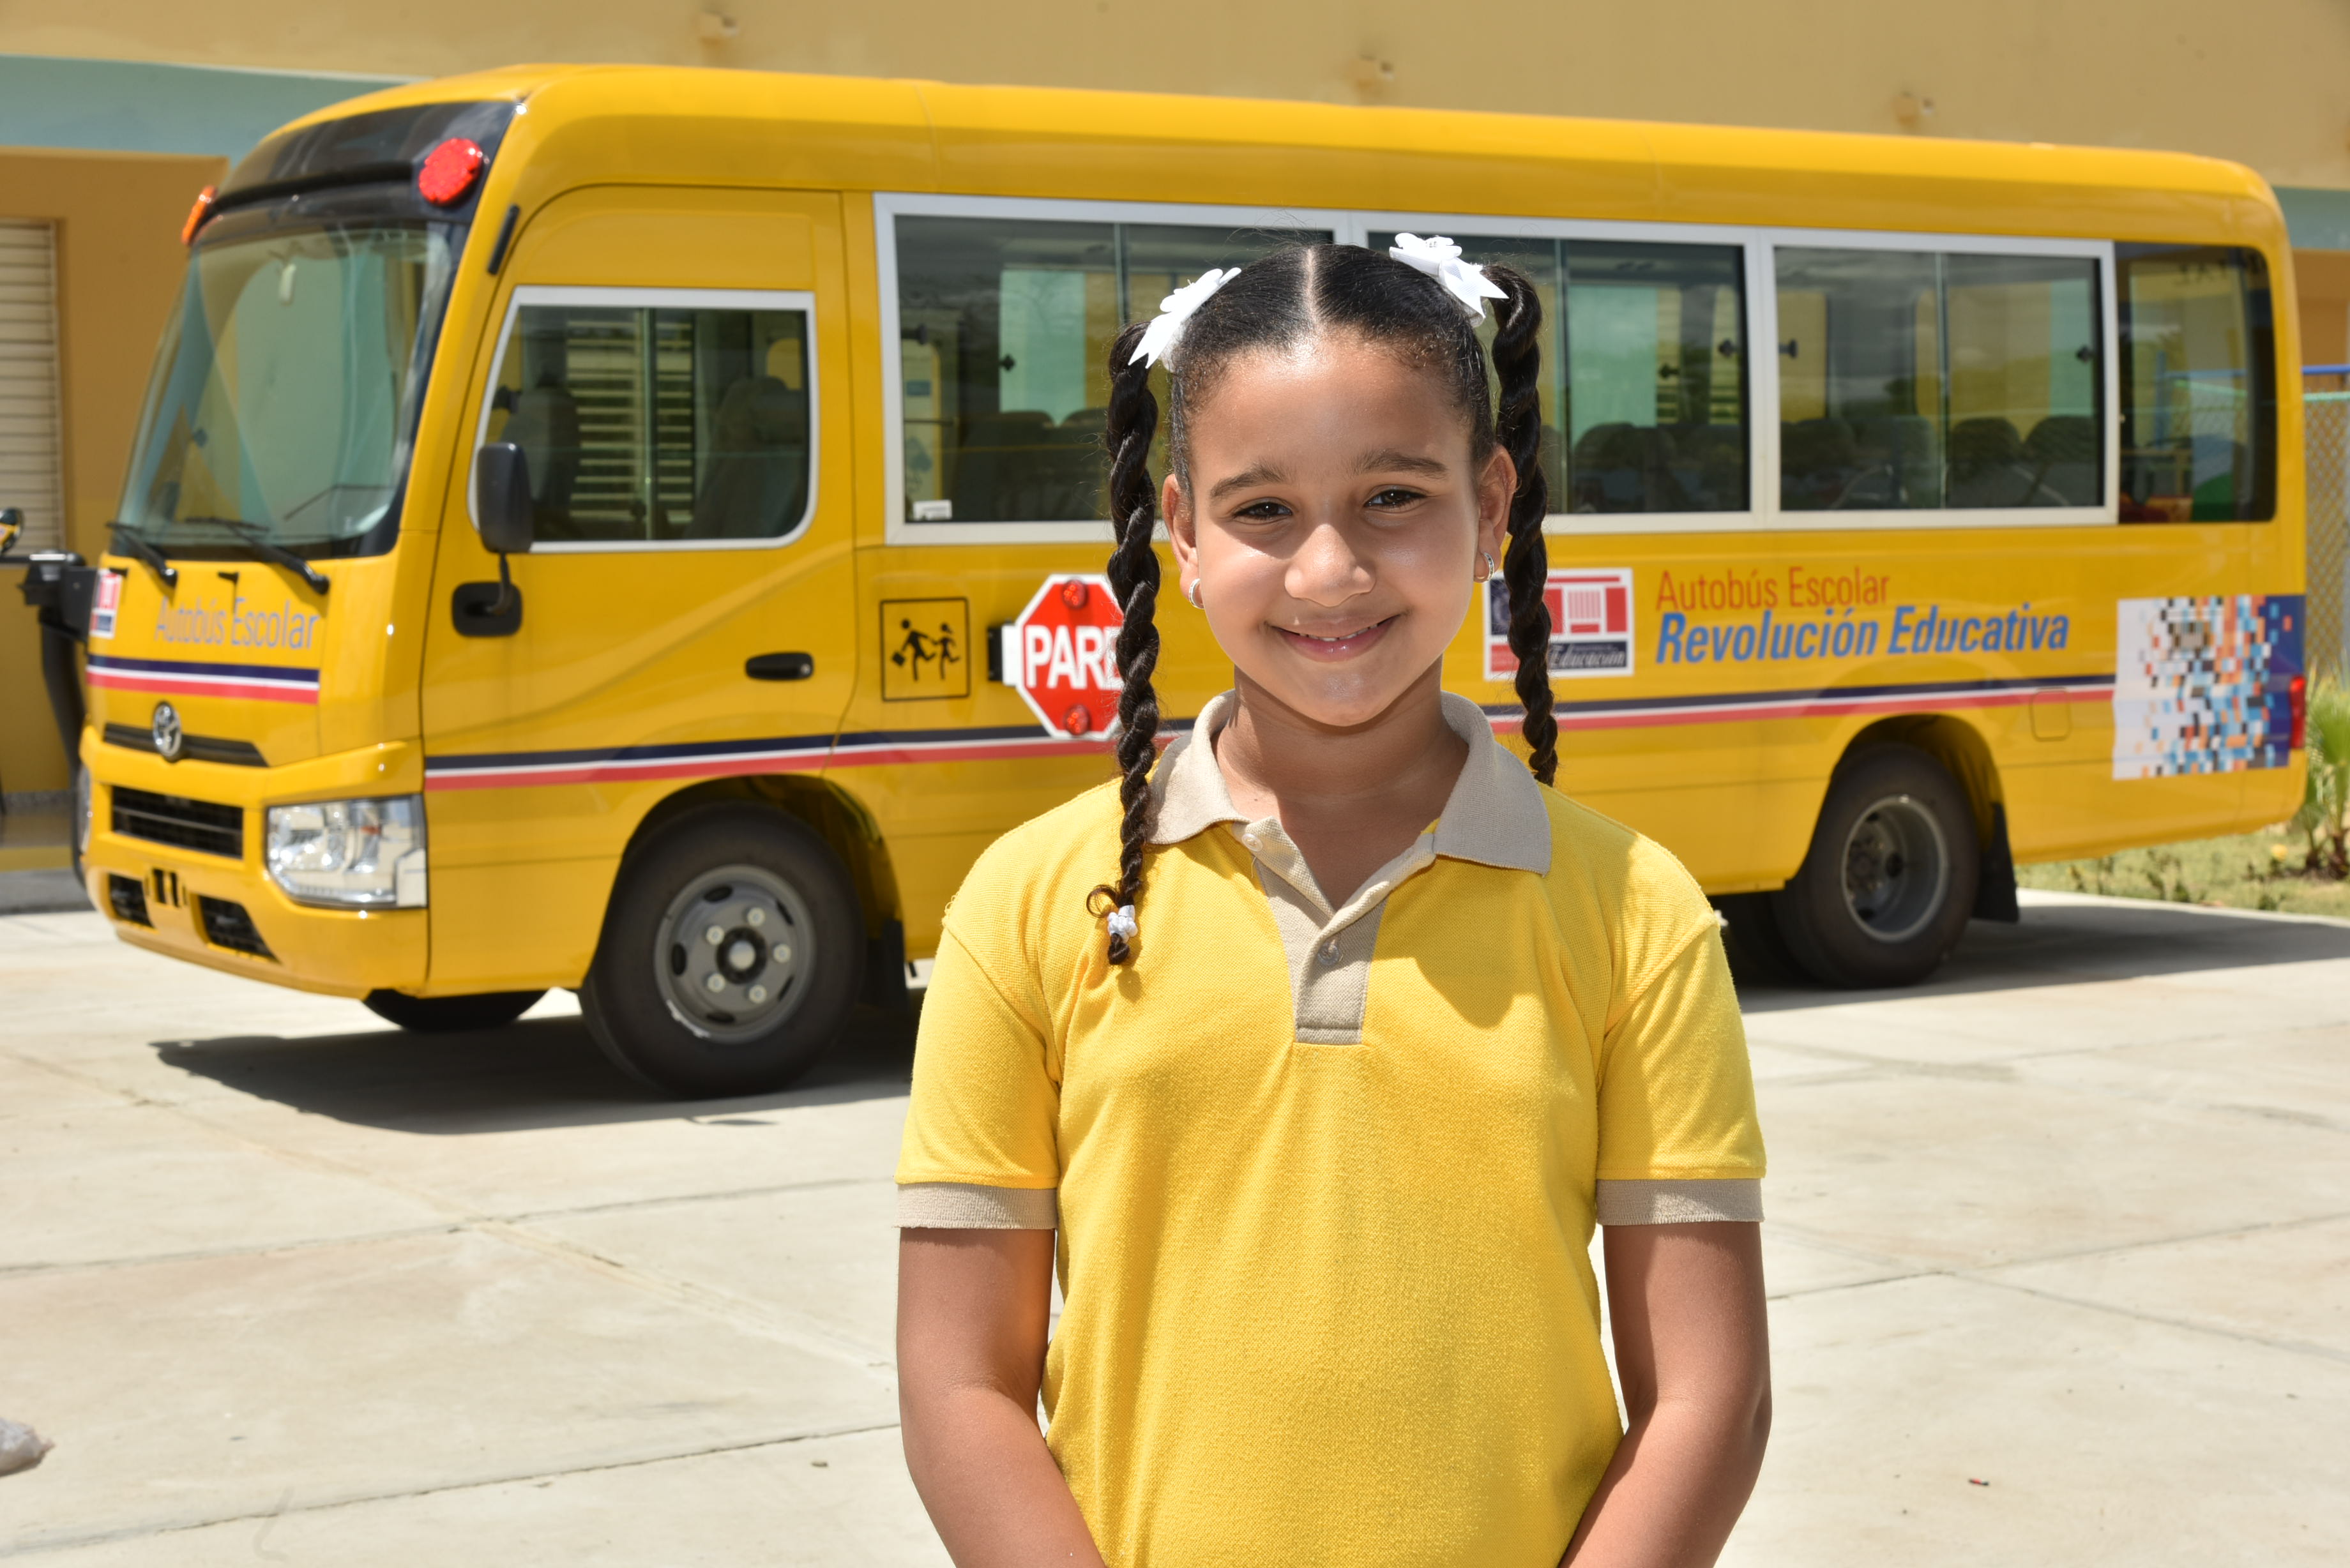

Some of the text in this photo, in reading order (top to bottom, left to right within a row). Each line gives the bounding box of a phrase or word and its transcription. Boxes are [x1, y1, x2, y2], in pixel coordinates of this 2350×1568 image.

[1655, 566, 1890, 611] Autobús Escolar
[154, 596, 320, 650] Autobús Escolar
[1655, 602, 2070, 665] Revolución Educativa
